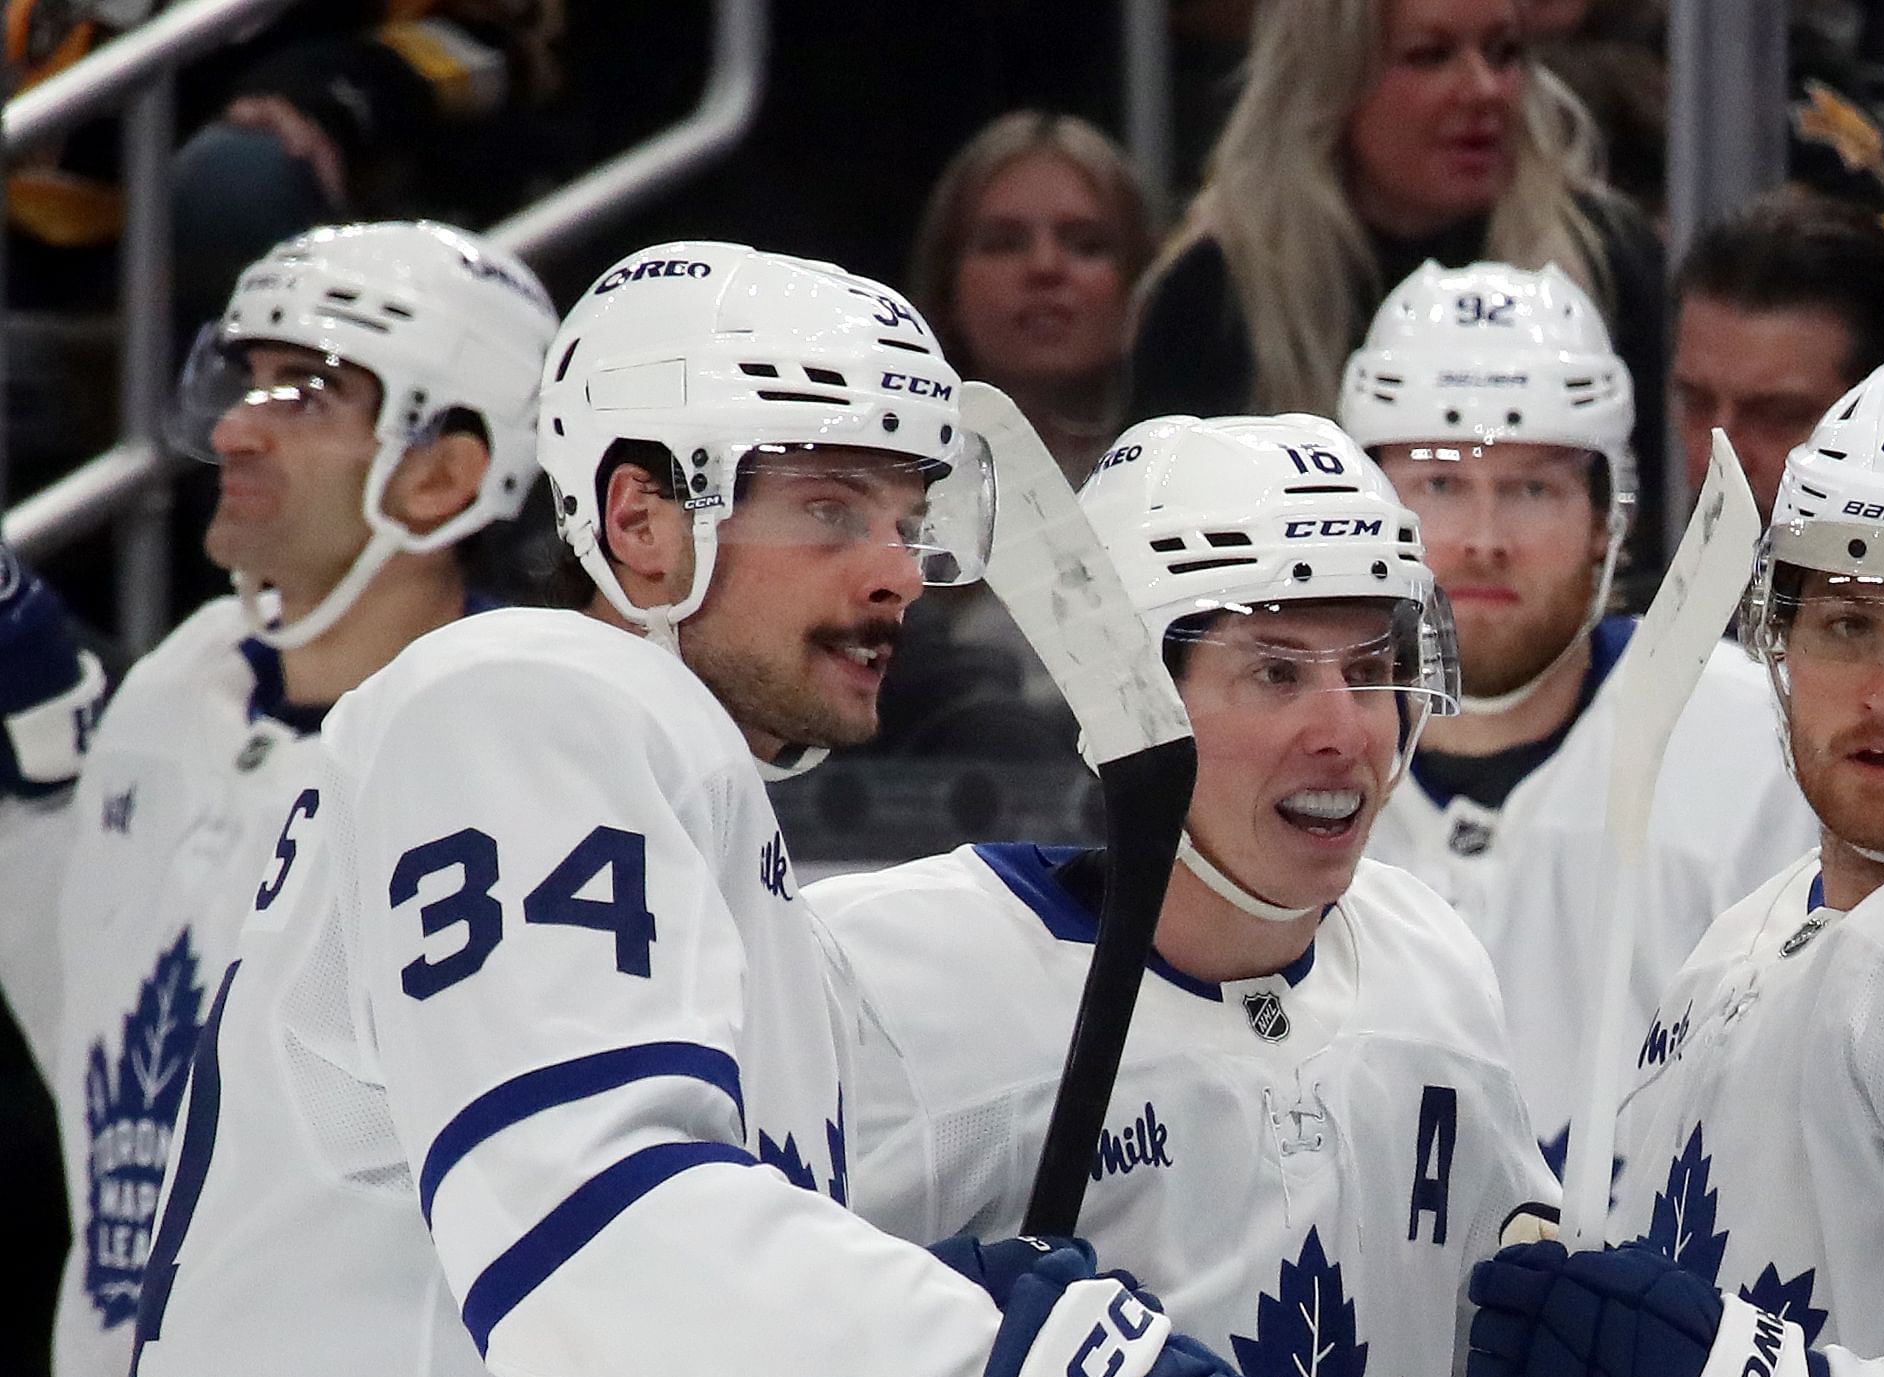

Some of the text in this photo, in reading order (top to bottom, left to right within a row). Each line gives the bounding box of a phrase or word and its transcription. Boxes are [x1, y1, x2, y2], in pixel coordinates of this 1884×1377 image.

[595, 260, 712, 295] OREO
[1456, 292, 1516, 328] 92
[881, 371, 953, 401] CCM
[684, 495, 720, 510] CCM
[1285, 519, 1383, 538] CCM
[760, 830, 793, 901] ilk
[389, 826, 657, 1000] 34
[1091, 1101, 1173, 1181] Milk
[1407, 1085, 1458, 1247] A
